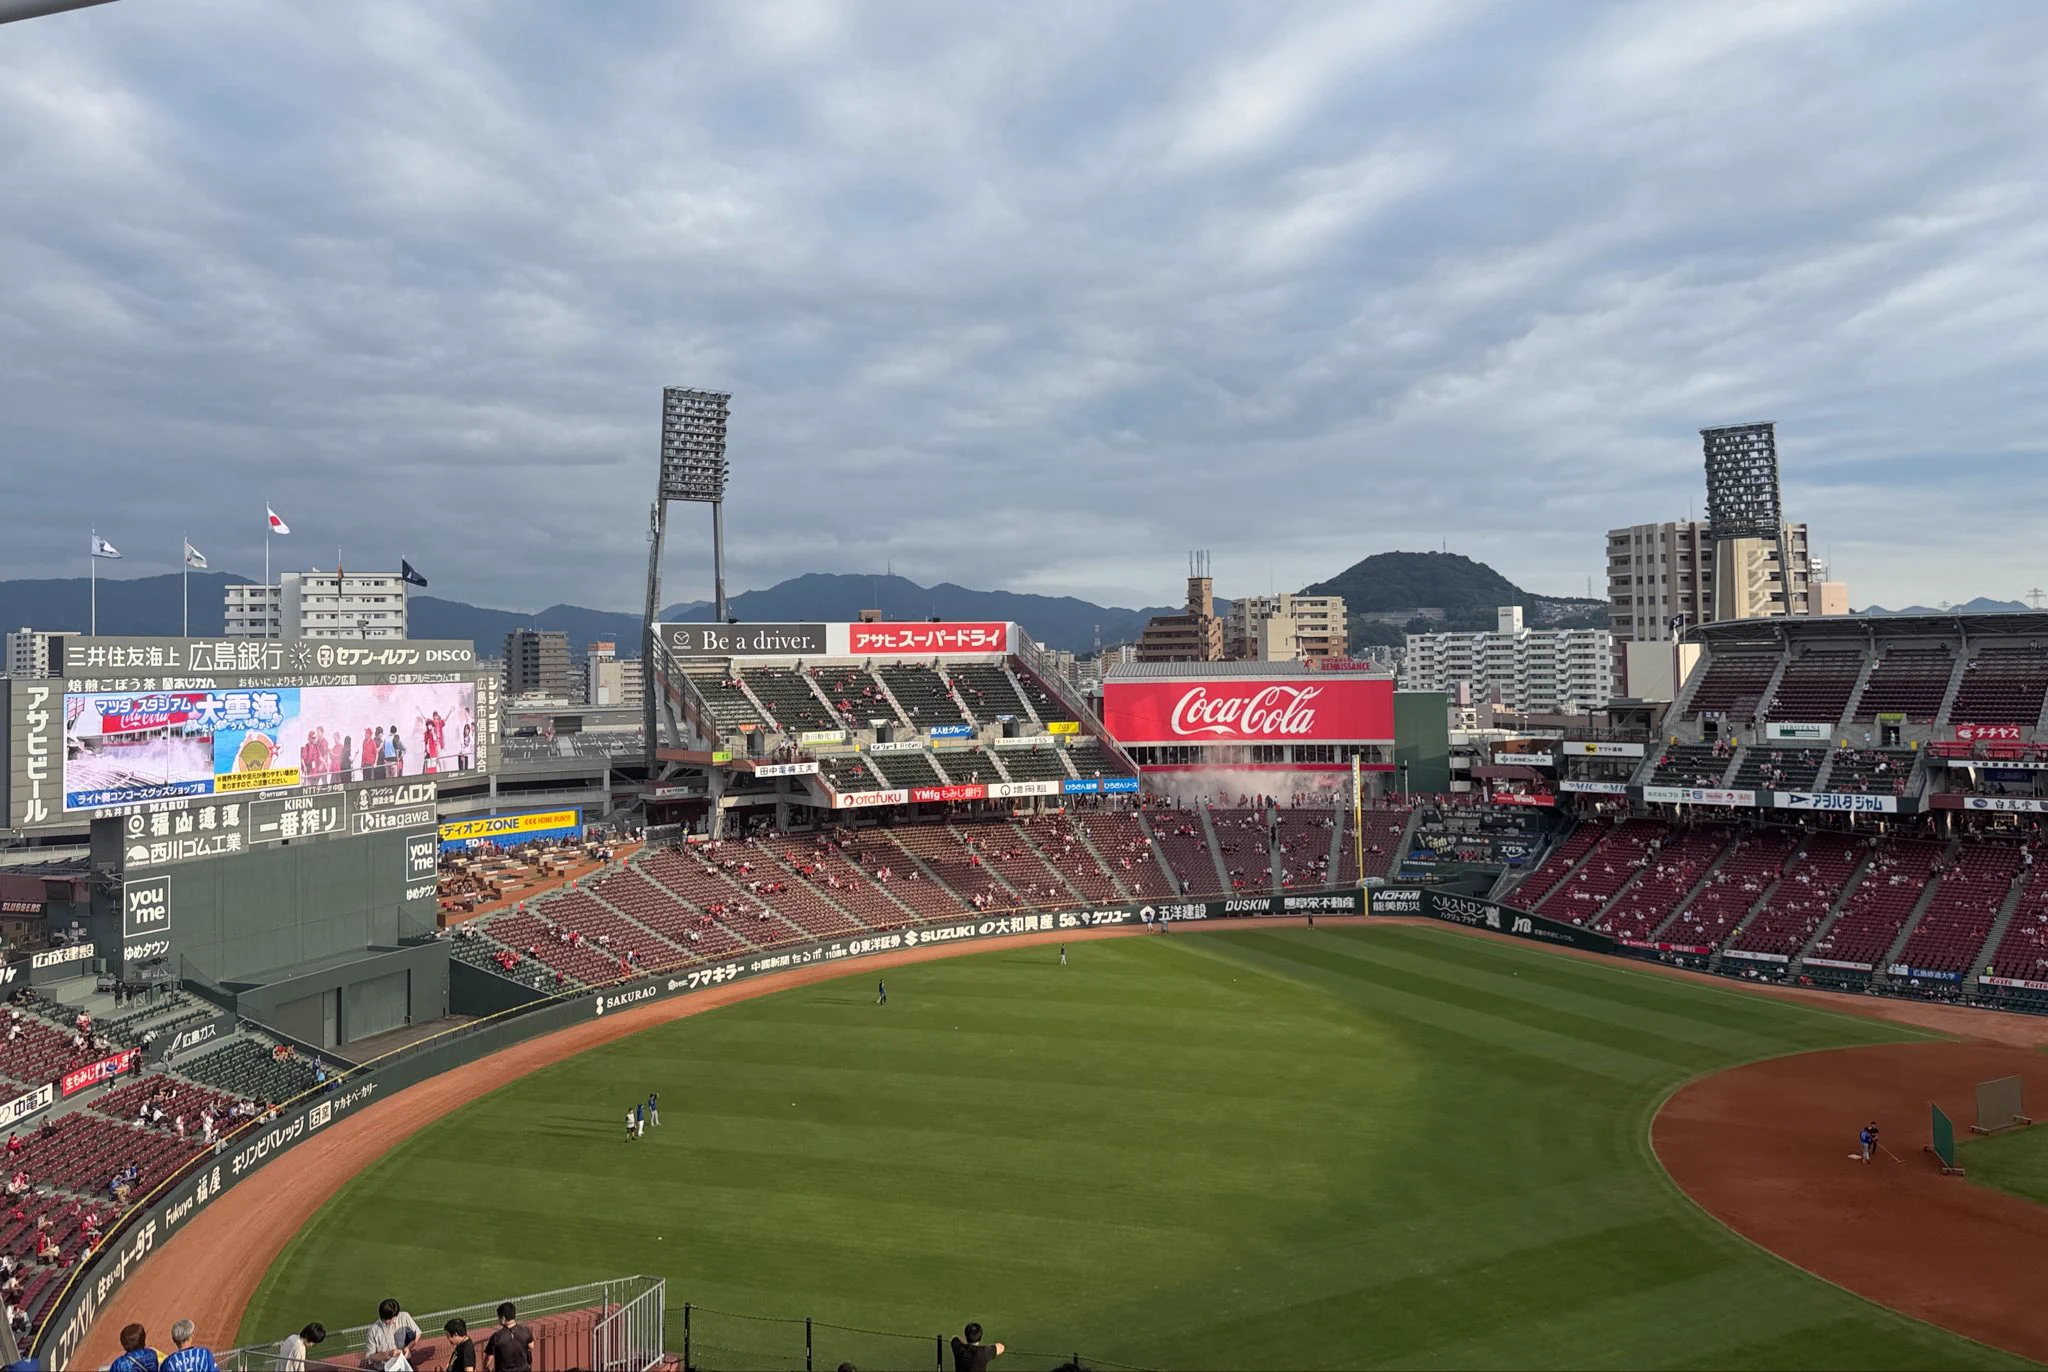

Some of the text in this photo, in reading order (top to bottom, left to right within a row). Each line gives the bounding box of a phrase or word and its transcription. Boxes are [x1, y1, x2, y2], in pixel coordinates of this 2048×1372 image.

[702, 629, 816, 650] Be a driver.
[67, 646, 180, 667] 三井住友海上
[188, 641, 284, 671] 広島銀行
[426, 649, 472, 662] DISCO
[1321, 662, 1370, 671] RENAISSANCE
[67, 677, 217, 693] 焙煎ごぼう茶 あじかん
[238, 674, 357, 687] おもいに、よりそう JAバンク広島
[397, 673, 461, 683] 広島アルミニウム工業
[195, 692, 281, 723] 大雲海
[1171, 685, 1324, 735] Coca-Cola
[476, 678, 487, 773] 広島市信用組合
[1976, 727, 2019, 738] チチヤス
[24, 686, 49, 823] アサヒビール
[394, 782, 437, 805] ムロオ
[941, 787, 983, 798] もみじ銀行
[149, 800, 190, 813] MARUI
[284, 797, 313, 811] KIRIN
[150, 803, 241, 837] 福山通運
[259, 806, 337, 837] 一番搾り
[486, 817, 520, 832] ZONE
[150, 832, 242, 864] 西川ゴム工業
[410, 842, 433, 862] you
[414, 857, 434, 871] me
[129, 887, 164, 912] you
[406, 884, 437, 901] ゆめタウン
[1373, 890, 1421, 900] NOHMI
[1, 902, 42, 913] SLUGGERS
[136, 907, 166, 924] me
[1158, 903, 1207, 921] 五洋建設
[1225, 899, 1270, 912] DUSKIN
[1373, 901, 1421, 912] 能美防災
[1432, 895, 1485, 915] ヘルストロン
[920, 924, 975, 943] SUZUKI
[996, 913, 1053, 934] 大和興産
[1511, 916, 1532, 934] JTB
[124, 940, 170, 961] ゆめタウン
[861, 934, 901, 953] 東洋証券
[32, 943, 95, 969] 広成建設
[688, 963, 745, 989] フマキラー
[606, 986, 657, 1009] SAKURAO
[182, 1023, 217, 1049] 広島ガス
[65, 1067, 96, 1090] 生もみじ
[14, 1088, 49, 1117] 中電工
[333, 1082, 378, 1114] タカキベーカリー
[232, 1115, 304, 1175] キリンビバレッジ
[165, 1165, 221, 1229] Fukuya 福屋
[97, 1218, 157, 1306] 住まいのトータテ
